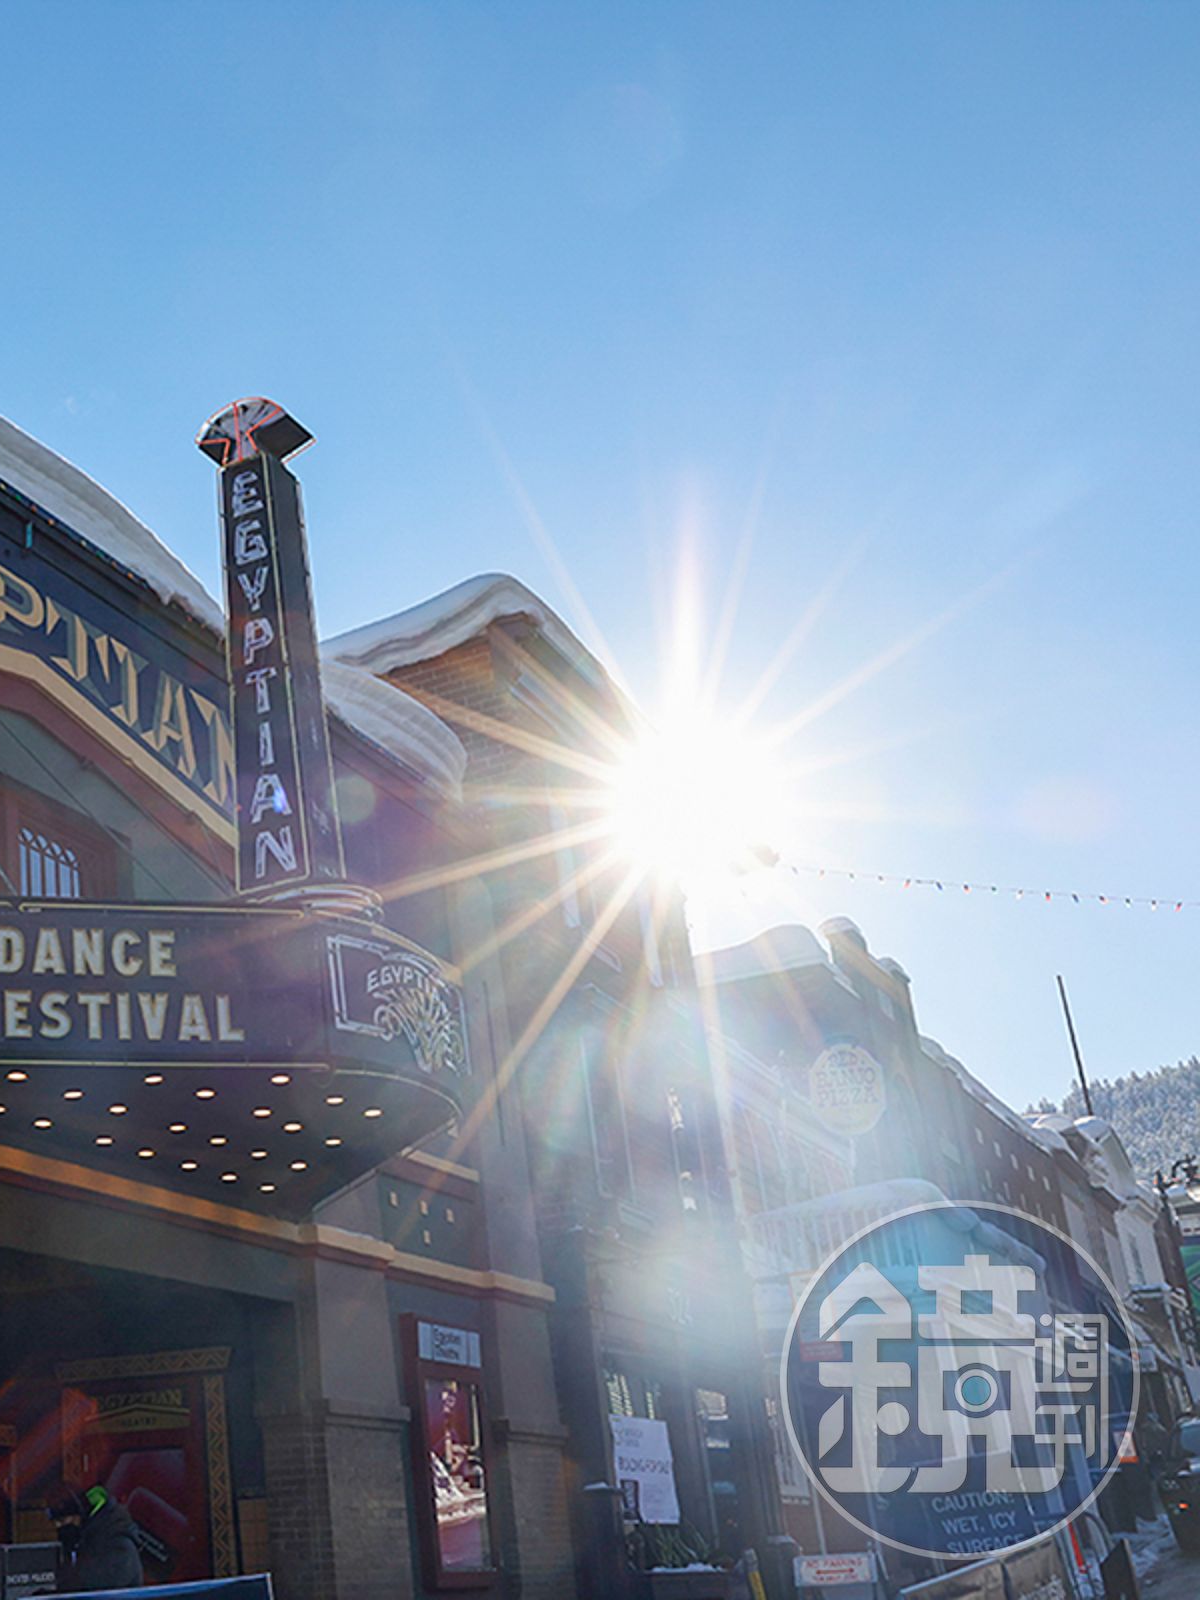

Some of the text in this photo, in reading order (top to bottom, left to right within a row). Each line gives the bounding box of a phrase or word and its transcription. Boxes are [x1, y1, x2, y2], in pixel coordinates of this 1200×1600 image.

[230, 470, 297, 880] EGYPTIAN
[931, 1489, 1015, 1513] CAUTION:
[942, 1511, 1017, 1535] WET, ICY
